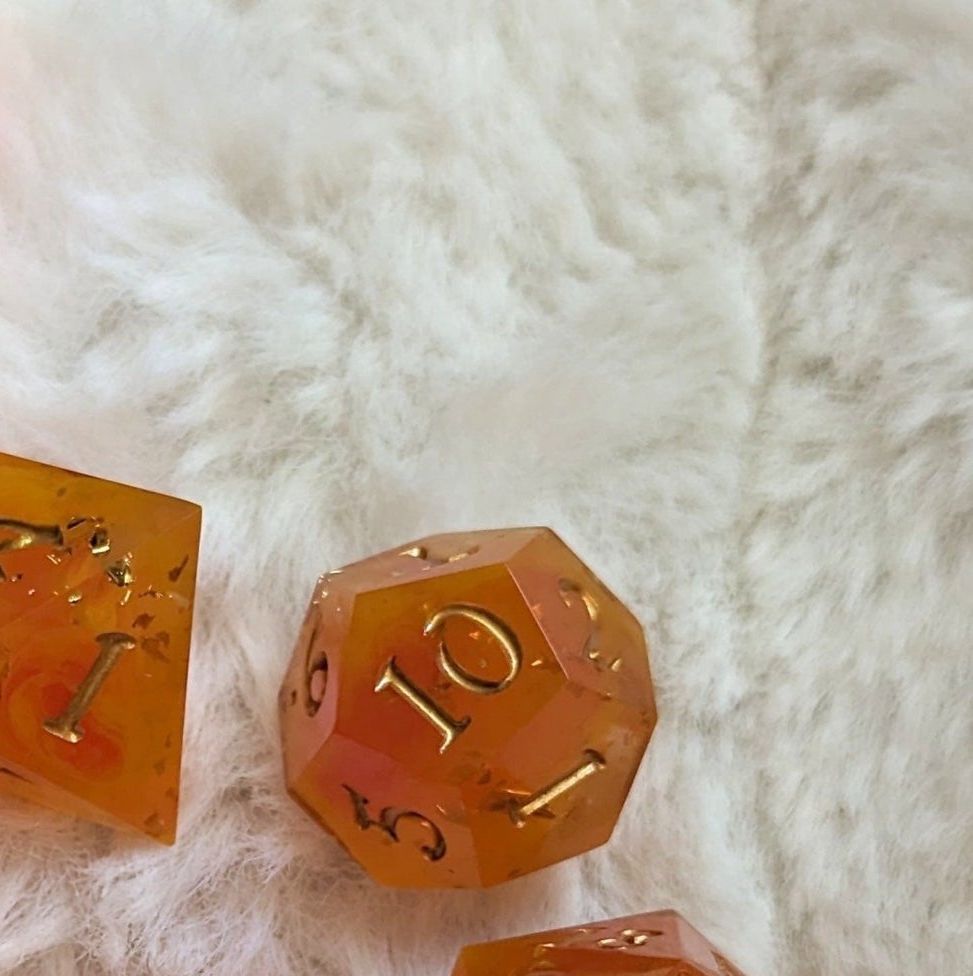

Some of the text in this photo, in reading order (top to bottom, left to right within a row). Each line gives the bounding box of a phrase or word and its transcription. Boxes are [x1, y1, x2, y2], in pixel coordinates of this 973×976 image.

[43, 632, 136, 743] 1
[374, 602, 523, 754] 10
[341, 783, 447, 863] 5
[491, 747, 607, 829] 1
